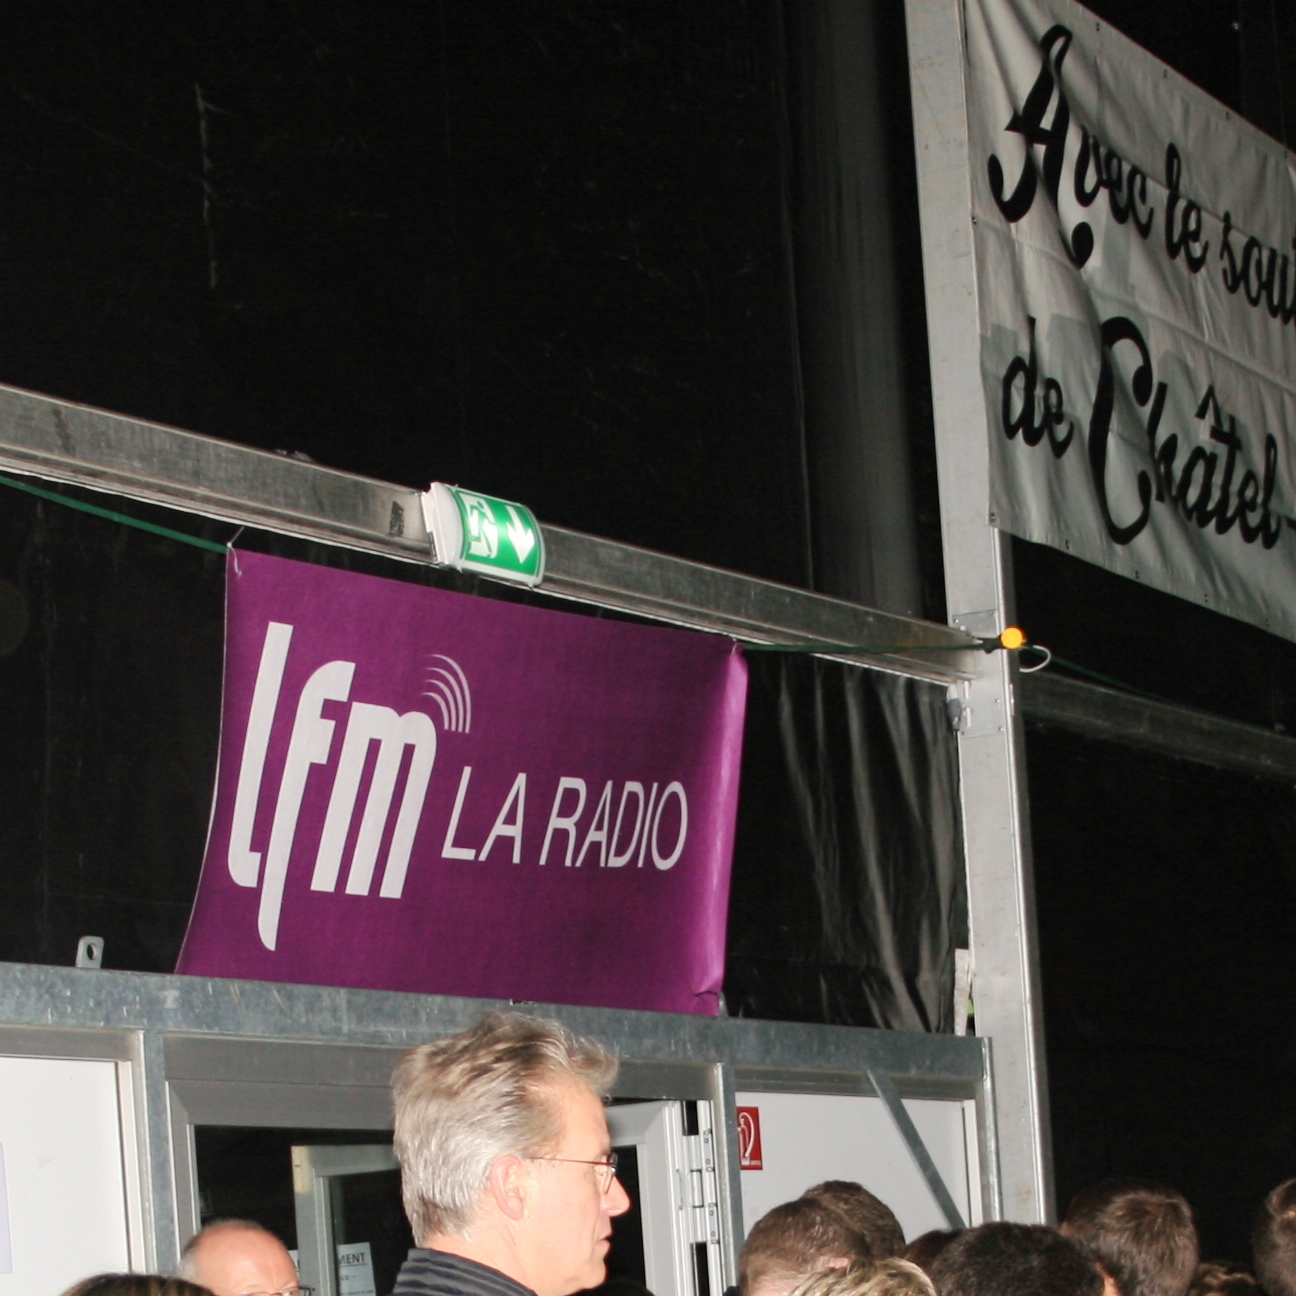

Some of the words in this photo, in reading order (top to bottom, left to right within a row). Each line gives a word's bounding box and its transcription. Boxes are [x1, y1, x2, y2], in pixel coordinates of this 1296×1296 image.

[987, 24, 1154, 270] Avec
[1165, 142, 1208, 274] le
[1002, 315, 1074, 459] de
[440, 766, 527, 864] LA
[538, 776, 689, 871] RADIO
